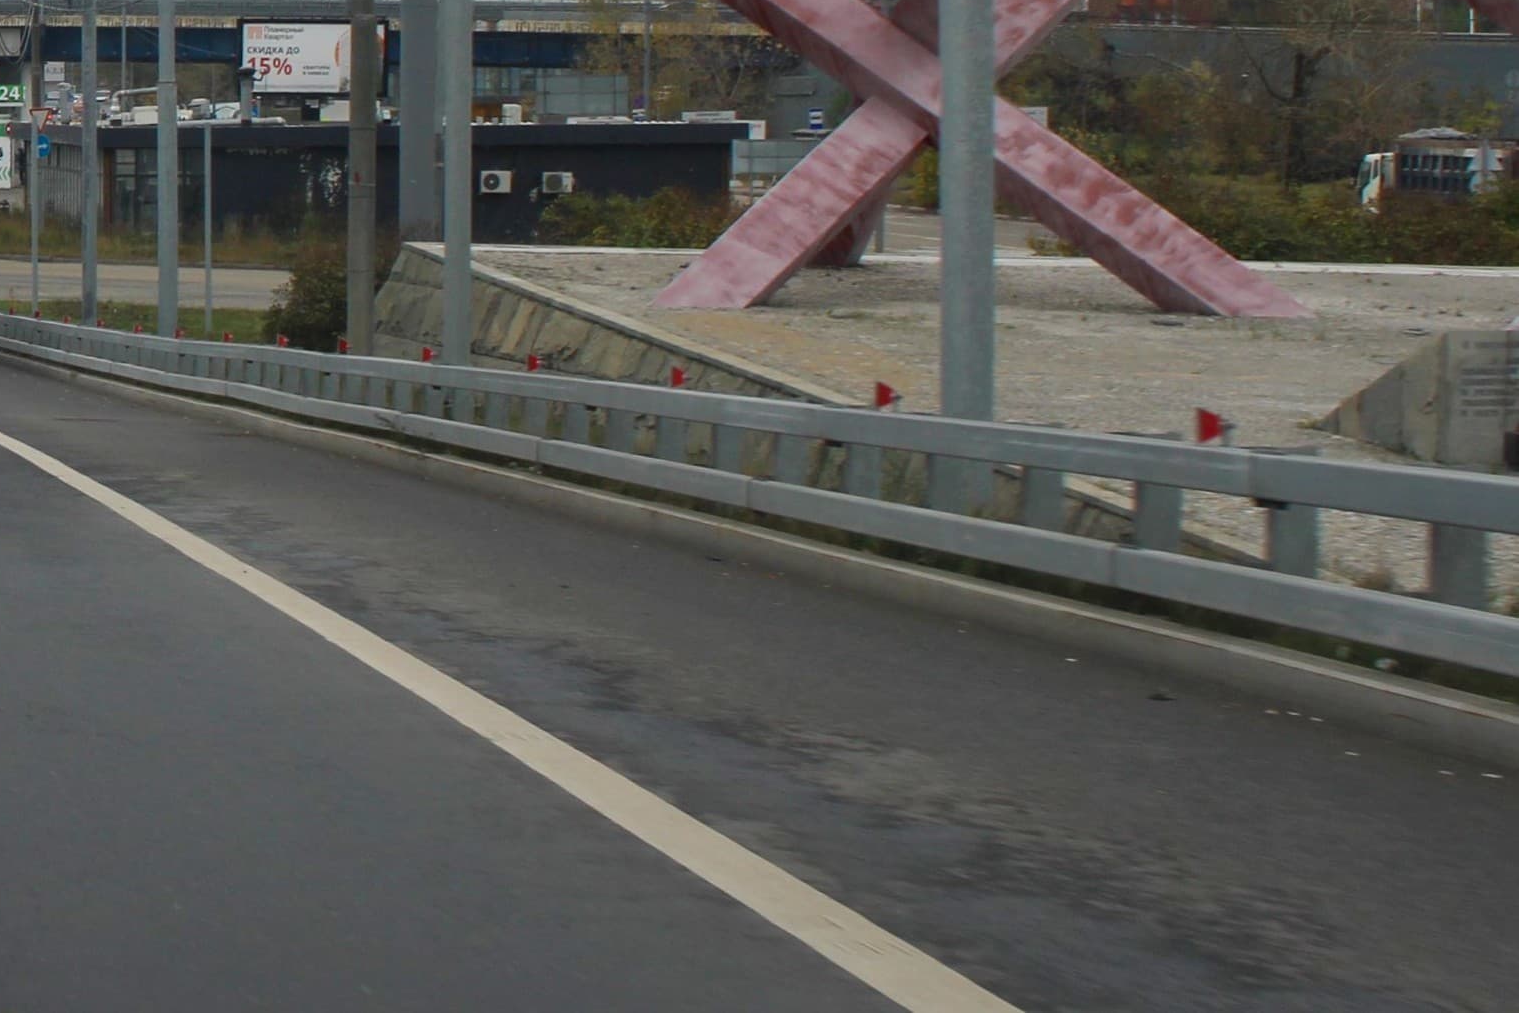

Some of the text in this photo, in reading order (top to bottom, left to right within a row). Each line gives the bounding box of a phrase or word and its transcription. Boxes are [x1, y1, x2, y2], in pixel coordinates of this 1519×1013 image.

[247, 47, 300, 55] СКИДКА ДО
[247, 57, 293, 75] 15%
